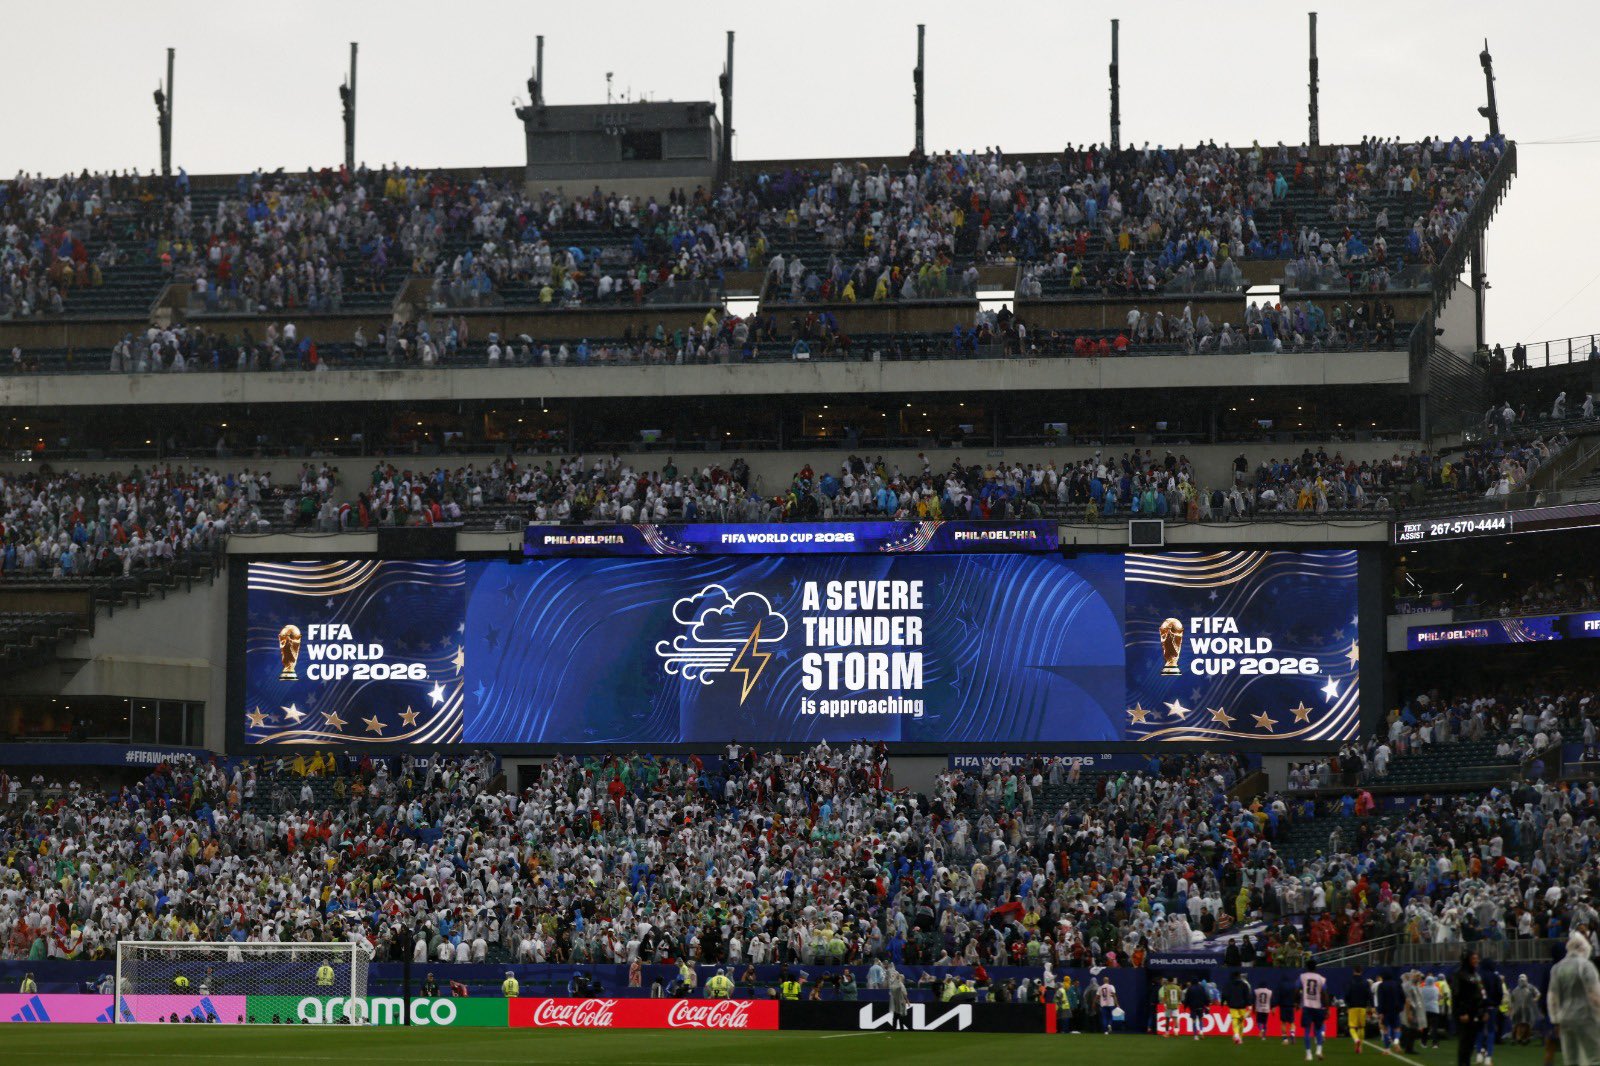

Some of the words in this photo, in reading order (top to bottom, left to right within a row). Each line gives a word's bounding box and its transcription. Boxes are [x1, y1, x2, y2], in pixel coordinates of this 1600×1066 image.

[954, 531, 1037, 541] PHILADELPHIA
[1403, 524, 1421, 532] TEXT
[1430, 518, 1506, 536] 267-570-4444
[543, 536, 624, 545] PHILADELPHIA
[721, 533, 746, 543] FIFA
[748, 533, 788, 543] WORLD
[790, 533, 813, 543] CUP
[815, 533, 855, 543] 2026
[1400, 532, 1425, 541] ASSIST
[801, 580, 821, 611] A
[826, 580, 924, 611] SEVERE
[307, 624, 352, 639] FIFA
[802, 616, 923, 647] THUNDER
[1190, 616, 1238, 633] FIFA
[1418, 629, 1489, 642] PHILADELPHIA
[306, 643, 385, 661] WORLD
[1189, 637, 1273, 655] WORLD
[306, 664, 350, 680] CUP
[352, 664, 427, 680] 2026
[801, 652, 923, 691] STORM
[1190, 658, 1236, 676] CUP
[1239, 658, 1320, 675] 2026
[801, 697, 817, 714] is
[819, 696, 924, 718] approaching
[954, 757, 980, 766] FIFA
[297, 997, 456, 1026] aramco
[533, 998, 618, 1027] Coca-Cola
[667, 999, 752, 1028] Coca-Cola
